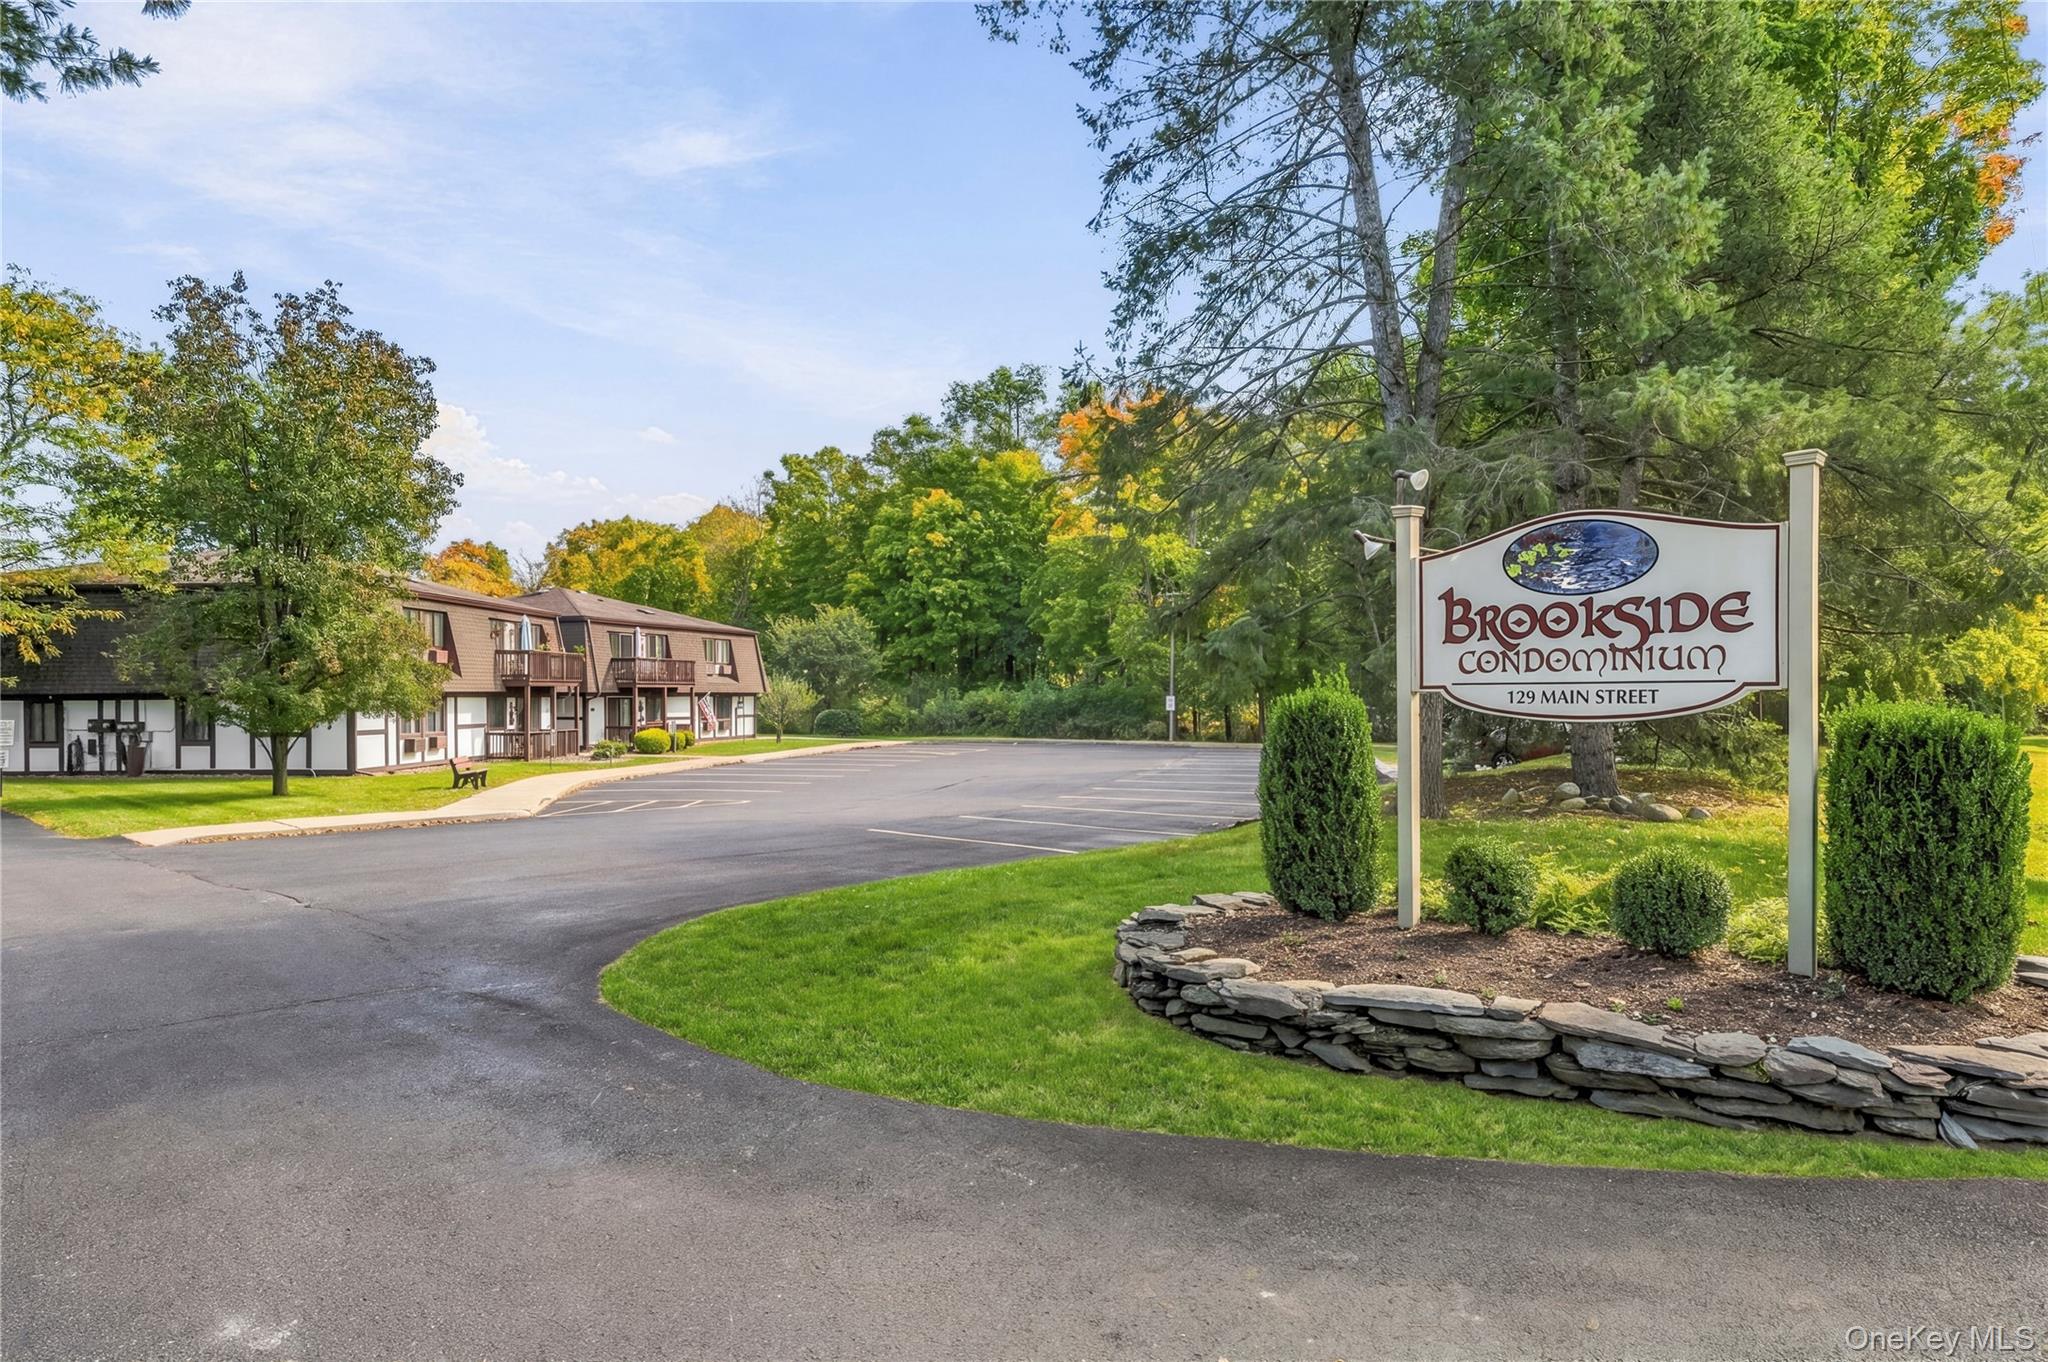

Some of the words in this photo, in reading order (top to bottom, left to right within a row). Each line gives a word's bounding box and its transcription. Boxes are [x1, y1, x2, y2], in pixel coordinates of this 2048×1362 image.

[1438, 587, 1754, 651] BROOKSIDE
[1458, 643, 1727, 677] CONDOMINIUM
[1507, 689, 1536, 705] 129
[1540, 690, 1591, 705] MAIN
[1595, 688, 1660, 704] STREET
